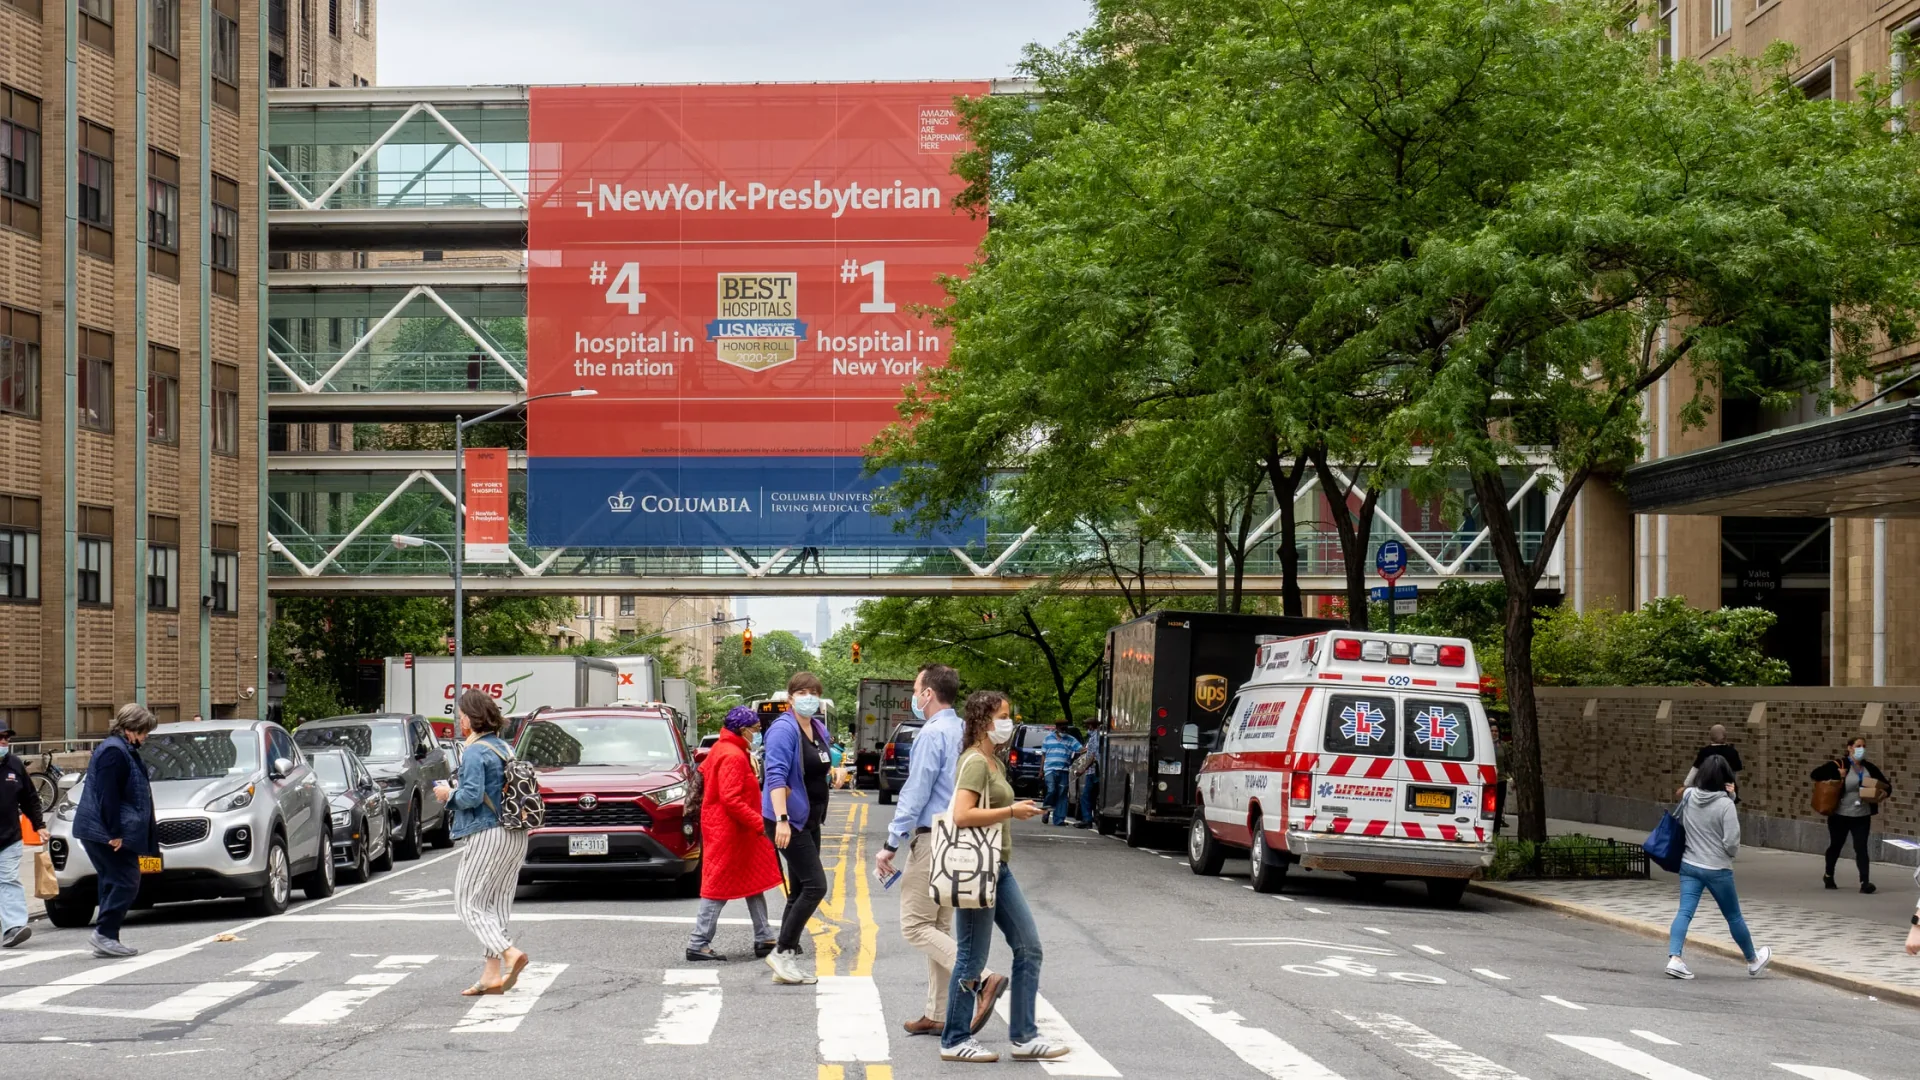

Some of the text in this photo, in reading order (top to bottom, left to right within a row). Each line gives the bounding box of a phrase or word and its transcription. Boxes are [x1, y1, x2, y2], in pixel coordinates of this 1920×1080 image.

[598, 180, 941, 219] NewYork-Presbyterian
[589, 261, 647, 315] #4
[722, 277, 792, 300] BEST
[840, 259, 896, 313] #1
[722, 302, 792, 317] HOSPITALS
[575, 331, 694, 360] hospital in
[723, 342, 790, 351] HONOR ROLL
[817, 330, 939, 359] hospital in
[736, 353, 778, 363] 2020-21
[832, 357, 924, 375] New York
[574, 358, 673, 377] the nation
[641, 495, 752, 513] COLUMBIA
[771, 492, 888, 501] COLUMBIA UNIVERSI
[771, 504, 809, 512] IRVING
[812, 504, 859, 512] MEDICAL
[1748, 570, 1770, 578] Valet
[1743, 579, 1775, 590] Parking
[1388, 675, 1410, 687] 629
[1198, 686, 1225, 706] ups
[1334, 783, 1394, 798] LIFELINE
